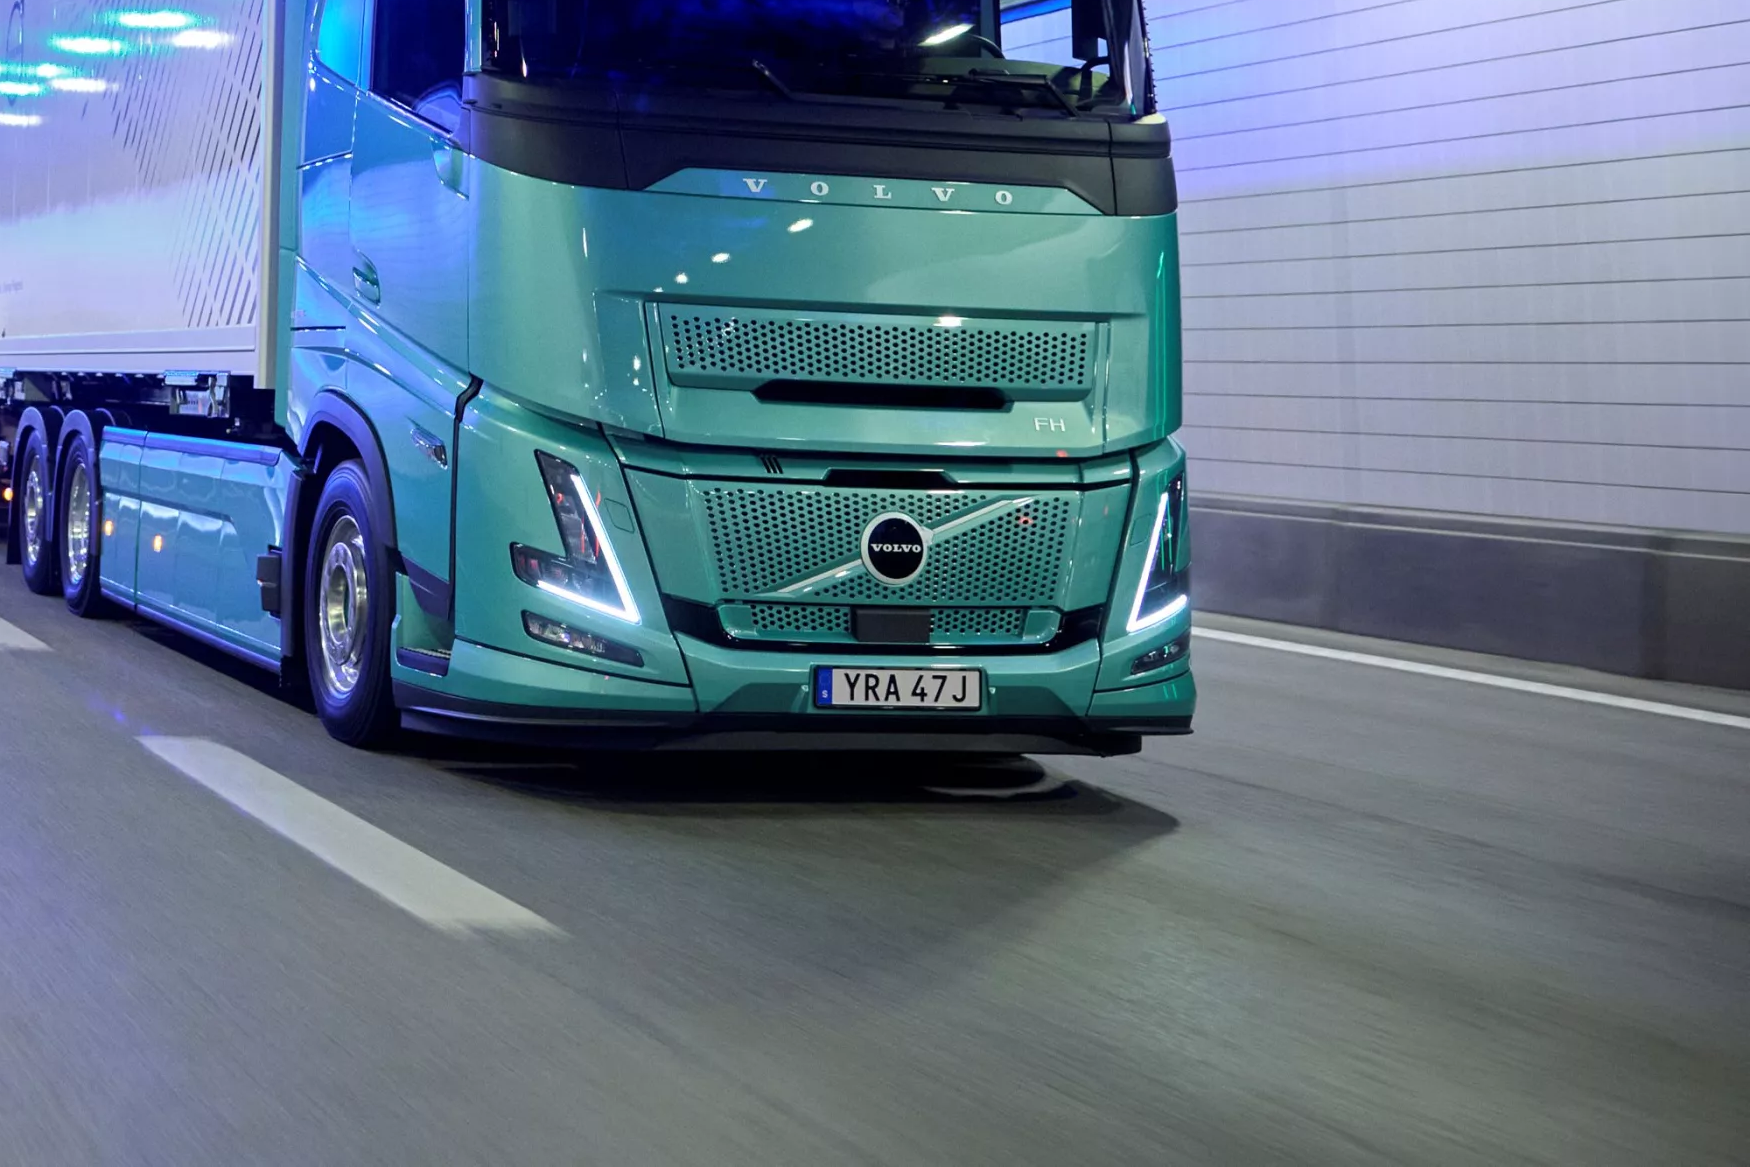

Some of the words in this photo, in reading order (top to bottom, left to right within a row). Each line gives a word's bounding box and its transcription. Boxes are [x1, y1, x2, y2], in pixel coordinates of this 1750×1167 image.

[742, 178, 1013, 205] VOLVO
[1034, 417, 1066, 432] FH
[870, 543, 922, 553] VOLVO
[822, 690, 829, 699] S
[844, 672, 901, 702] YRA
[911, 674, 967, 703] 47J
